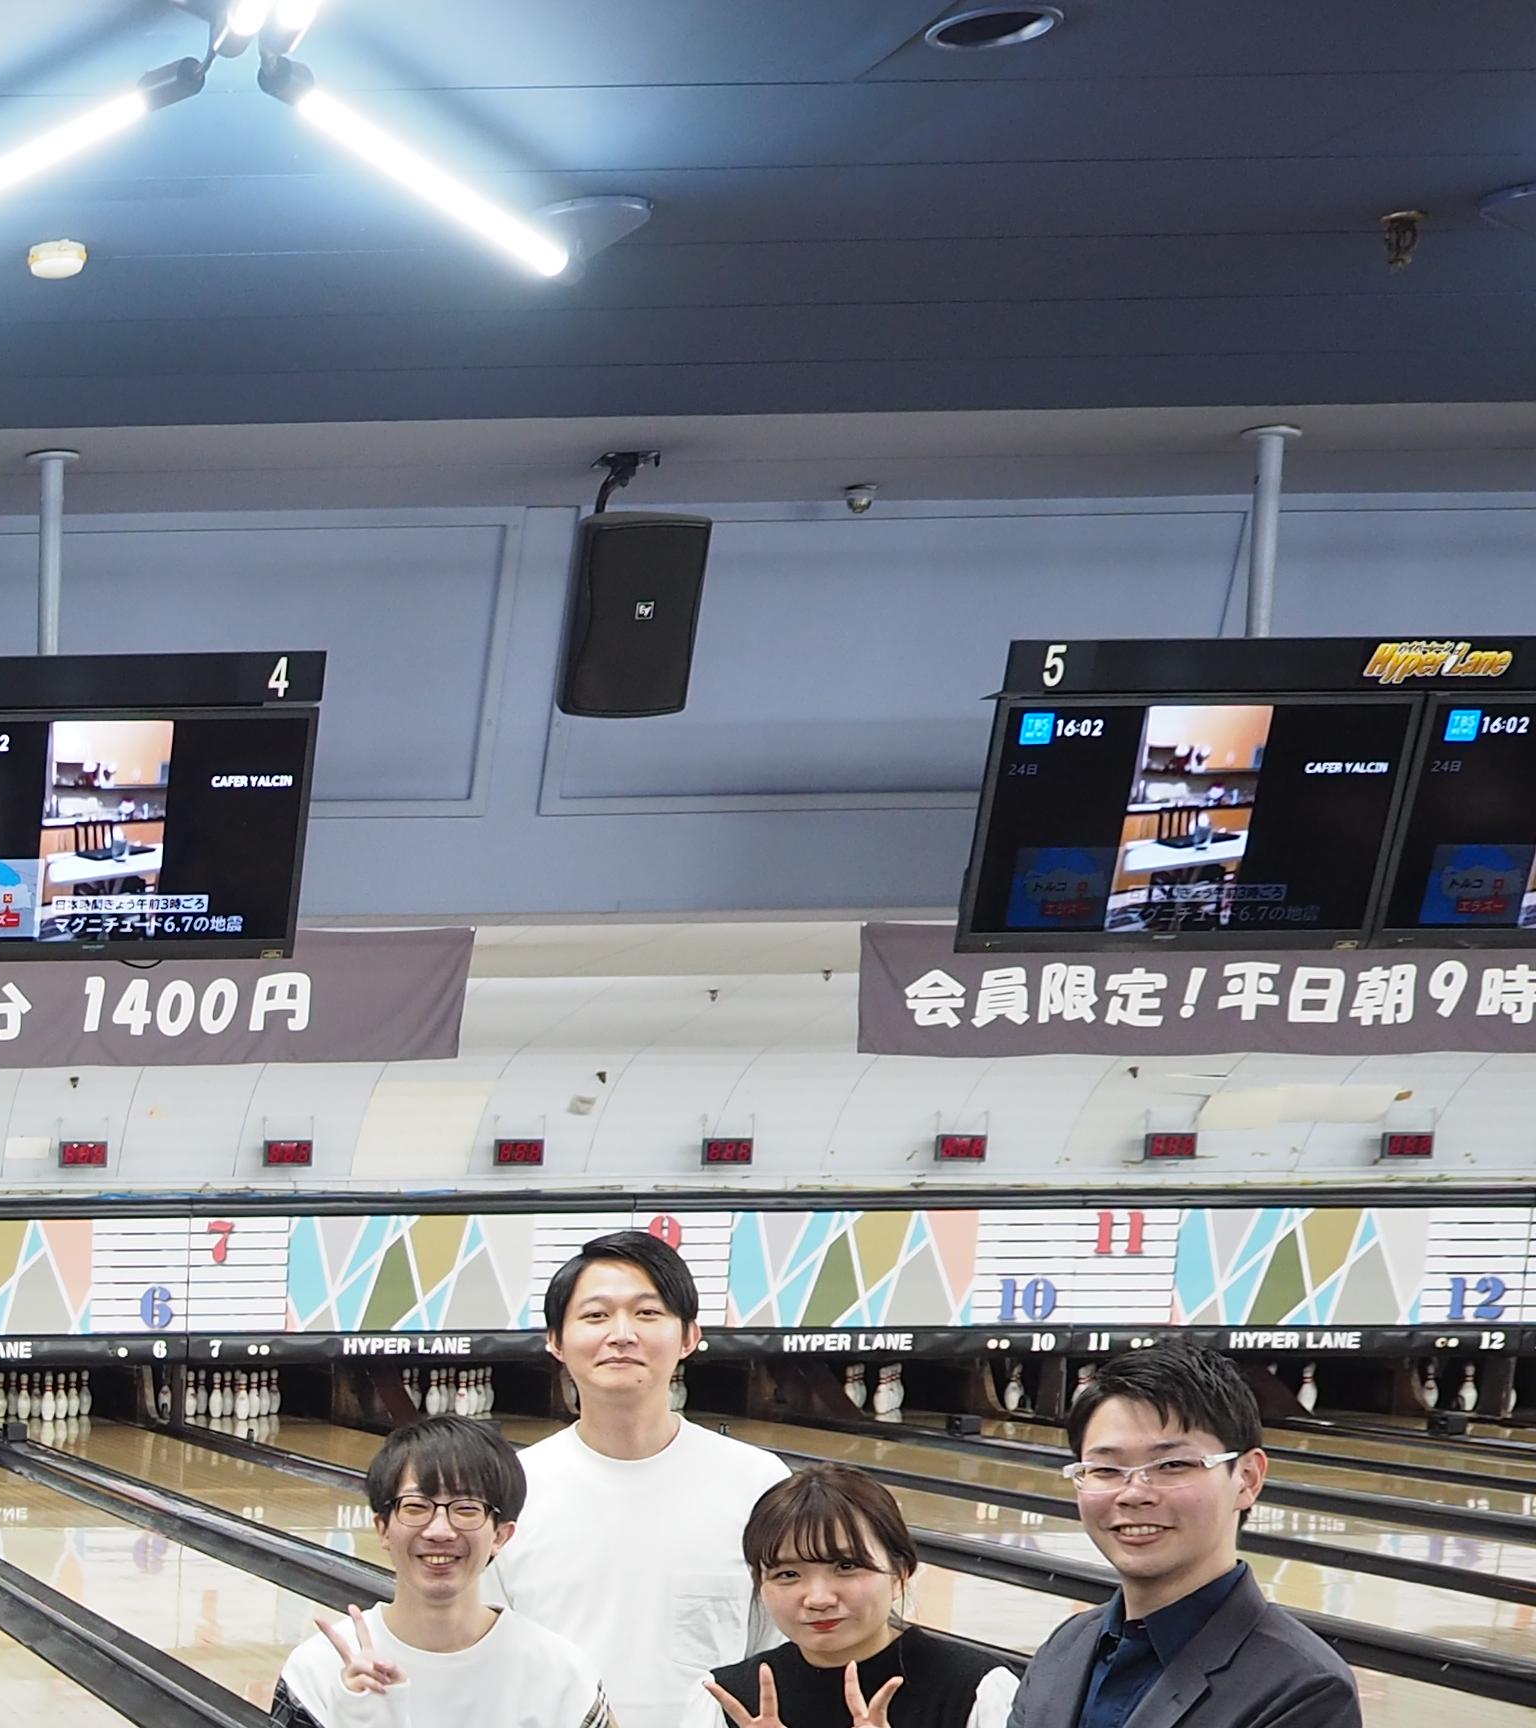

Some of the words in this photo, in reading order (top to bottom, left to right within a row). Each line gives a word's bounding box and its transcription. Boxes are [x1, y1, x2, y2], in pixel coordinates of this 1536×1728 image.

[1042, 644, 1067, 687] 5
[1363, 642, 1448, 684] Hyper
[1450, 643, 1513, 677] Lane
[268, 656, 289, 698] 4
[1056, 718, 1104, 737] 16:02
[1481, 714, 1530, 734] 16:02
[211, 776, 247, 787] CAFER
[1033, 881, 1068, 893] トルコ
[1447, 877, 1485, 891] トルコ
[82, 971, 312, 1036] 1400円
[206, 1219, 235, 1265] 7
[1093, 1211, 1144, 1255] 11
[998, 1277, 1057, 1321] 10
[1447, 1275, 1506, 1319] 12
[138, 1285, 173, 1330] 6
[152, 1340, 168, 1358] 6
[209, 1339, 222, 1357] 7
[342, 1338, 412, 1356] HYPER
[417, 1337, 471, 1355] LANE
[782, 1333, 851, 1353] HYPER
[857, 1333, 914, 1352] LANE
[1030, 1332, 1055, 1351] 10
[1087, 1332, 1111, 1351] 11
[1229, 1331, 1301, 1350] HYPER
[1306, 1331, 1362, 1350] LANE
[1478, 1331, 1505, 1350] 12
